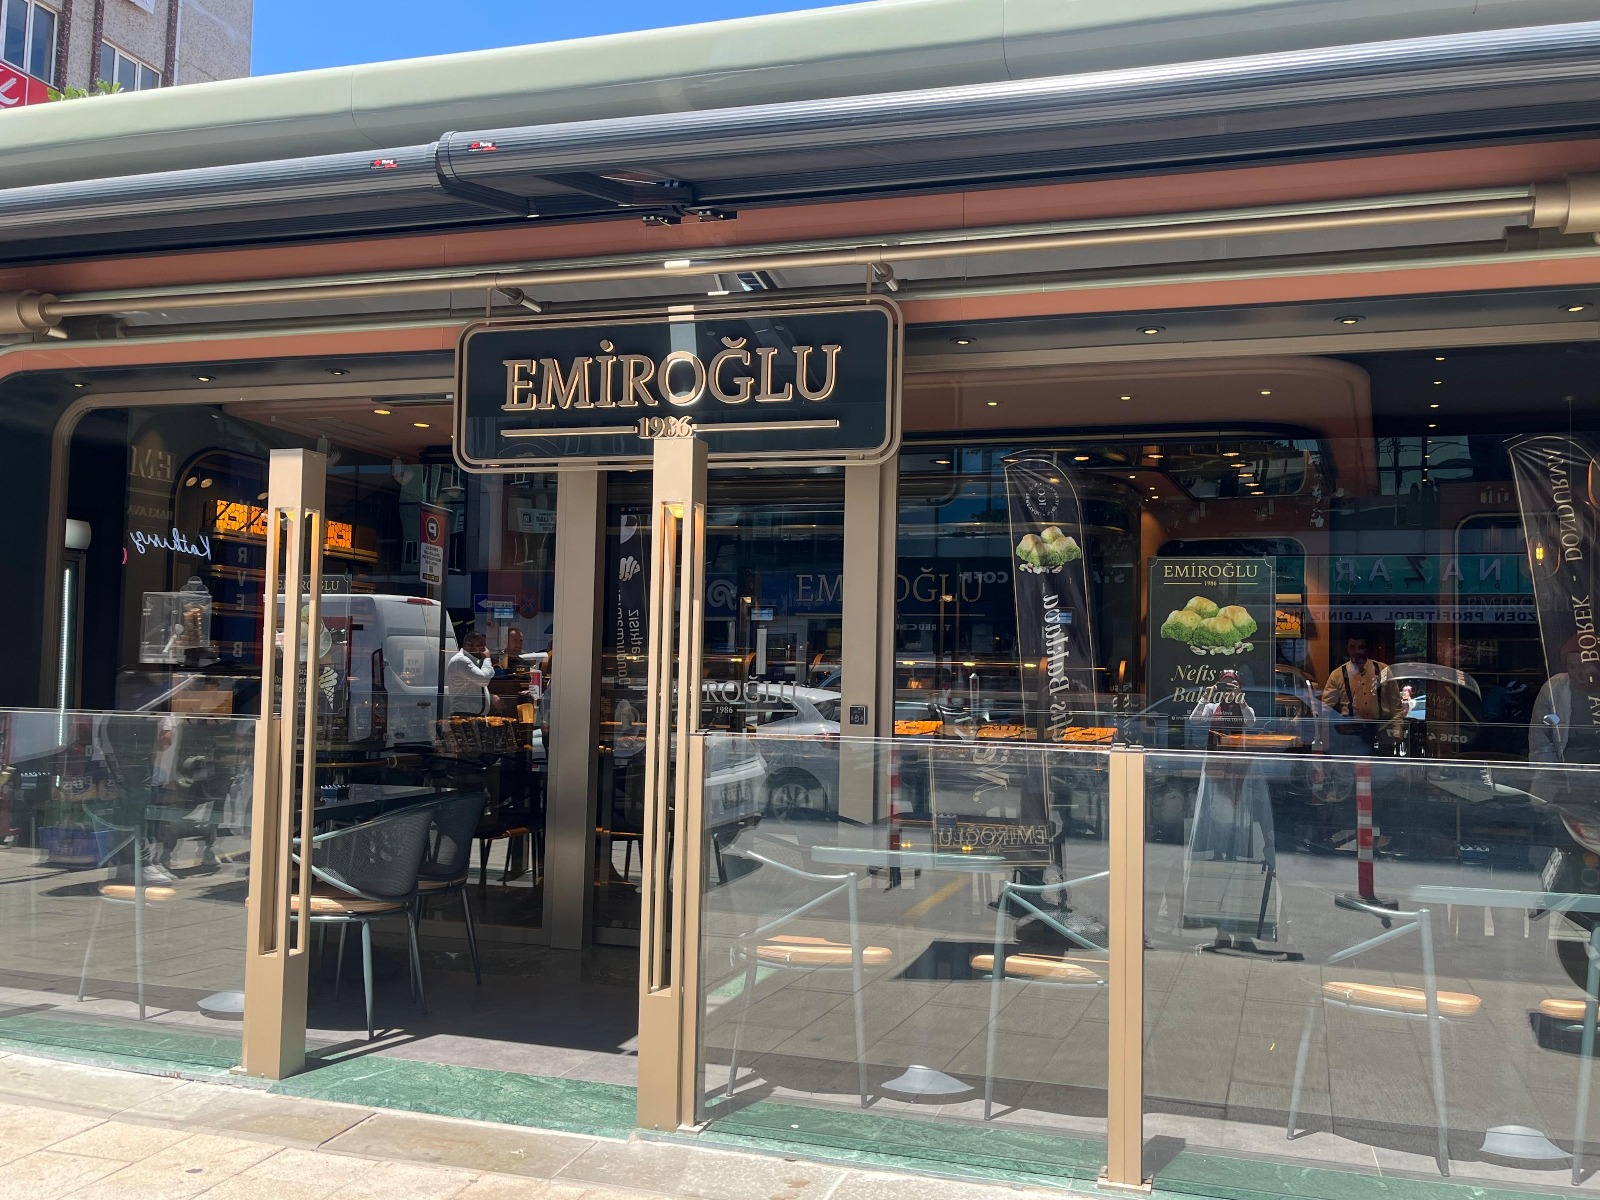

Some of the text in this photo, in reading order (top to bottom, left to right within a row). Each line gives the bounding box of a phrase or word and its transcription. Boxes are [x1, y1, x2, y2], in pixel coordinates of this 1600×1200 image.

[501, 337, 842, 412] EMİROĞLU
[638, 416, 693, 439] 1986
[1163, 562, 1258, 578] EMİROĞLU
[795, 566, 984, 603] EMOĞLU
[1170, 664, 1217, 684] Nefis
[702, 675, 798, 704] ROĞLU
[1172, 686, 1246, 704] Baklava
[716, 706, 734, 715] 1986
